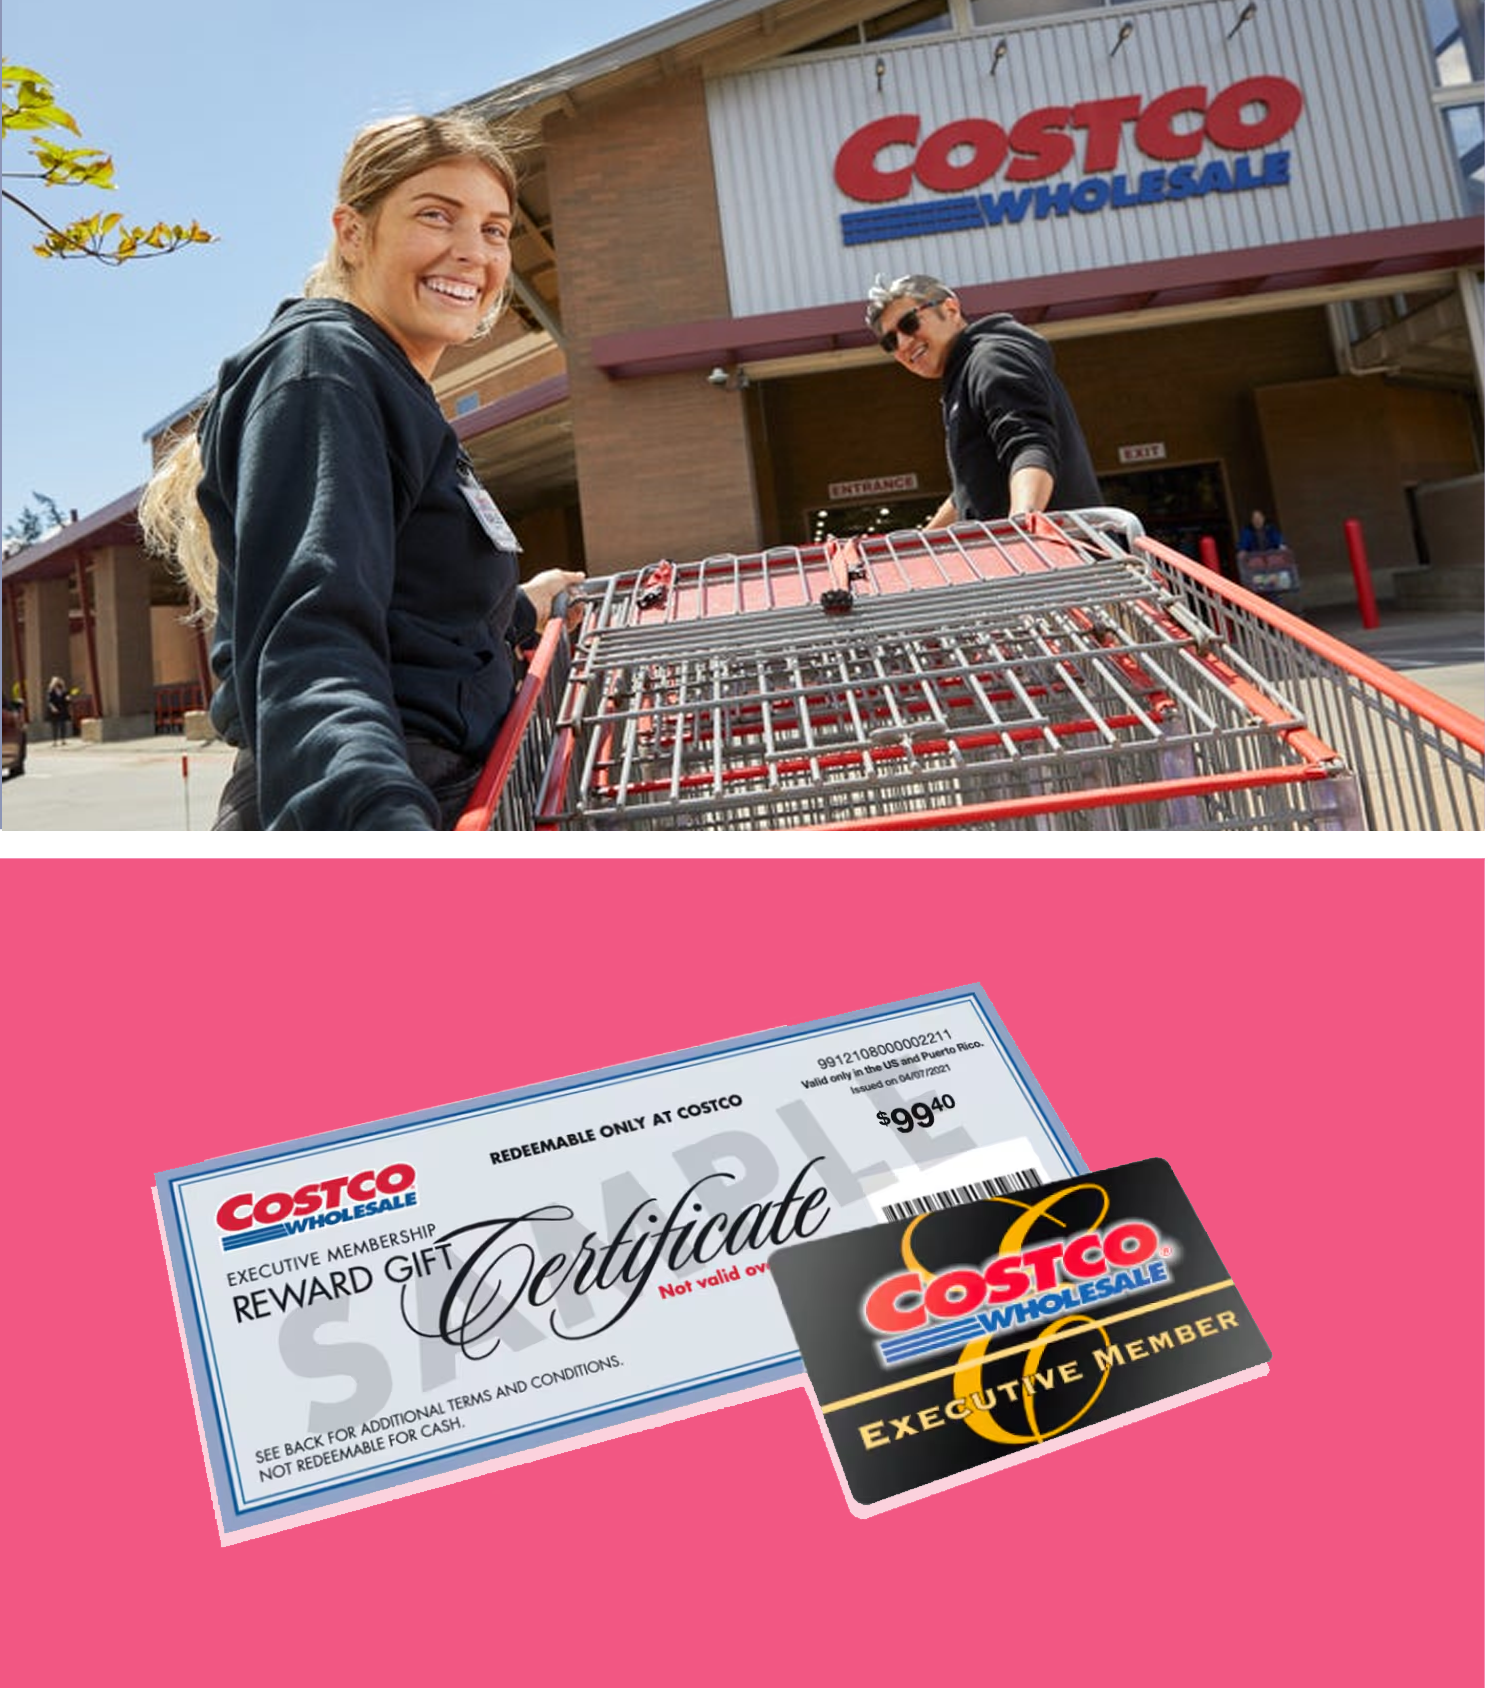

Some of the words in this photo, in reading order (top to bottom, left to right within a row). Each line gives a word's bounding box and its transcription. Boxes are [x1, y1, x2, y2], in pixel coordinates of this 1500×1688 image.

[834, 75, 1304, 202] COSTCO
[981, 150, 1291, 225] WHOLESALE
[832, 476, 915, 496] ENTRANCE
[1124, 444, 1161, 459] EXIT
[801, 1077, 829, 1090] Valid
[830, 1069, 852, 1084] only
[853, 1067, 865, 1078] in
[865, 1063, 882, 1074] the
[883, 1057, 899, 1069] US
[900, 1053, 921, 1066] and
[921, 1046, 957, 1062] Puerto
[957, 1040, 984, 1053] Rico.
[850, 1080, 883, 1095] Issued
[885, 1077, 898, 1087] on
[898, 1063, 952, 1084] 04/07/2021
[489, 1128, 597, 1166] REDEEMABLE
[599, 1116, 646, 1139] ONLY
[652, 1110, 673, 1127] AT
[677, 1094, 743, 1120] COSTCO
[216, 1163, 416, 1232] COSTCO
[284, 1191, 418, 1236] WHOLESALE
[227, 1251, 321, 1287] EXECUTIVE
[327, 1223, 437, 1263] MEMBERSHIP
[278, 1053, 978, 1433] SAMPLE
[400, 1156, 831, 1361] Certificate
[865, 1221, 1159, 1334] COSTCO
[232, 1265, 374, 1324] REWARD
[384, 1243, 453, 1284] GIFT
[658, 1280, 692, 1300] Not
[696, 1265, 741, 1289] valid
[978, 1260, 1168, 1333] WHOLESALE
[255, 1445, 281, 1465] SEE
[284, 1434, 325, 1457] BACK
[327, 1426, 357, 1445] FOR
[361, 1402, 446, 1437] ADDITIONAL
[447, 1389, 492, 1412] TERMS
[496, 1380, 528, 1400] AND
[530, 1354, 625, 1390] CONDITIONS.
[858, 1360, 1084, 1451] EXECUTIVE
[1092, 1309, 1241, 1372] MEMBER
[259, 1462, 293, 1483] NOT
[297, 1437, 386, 1473] REDEEMABLE
[388, 1428, 418, 1448] FOR
[420, 1416, 466, 1438] CASH.
